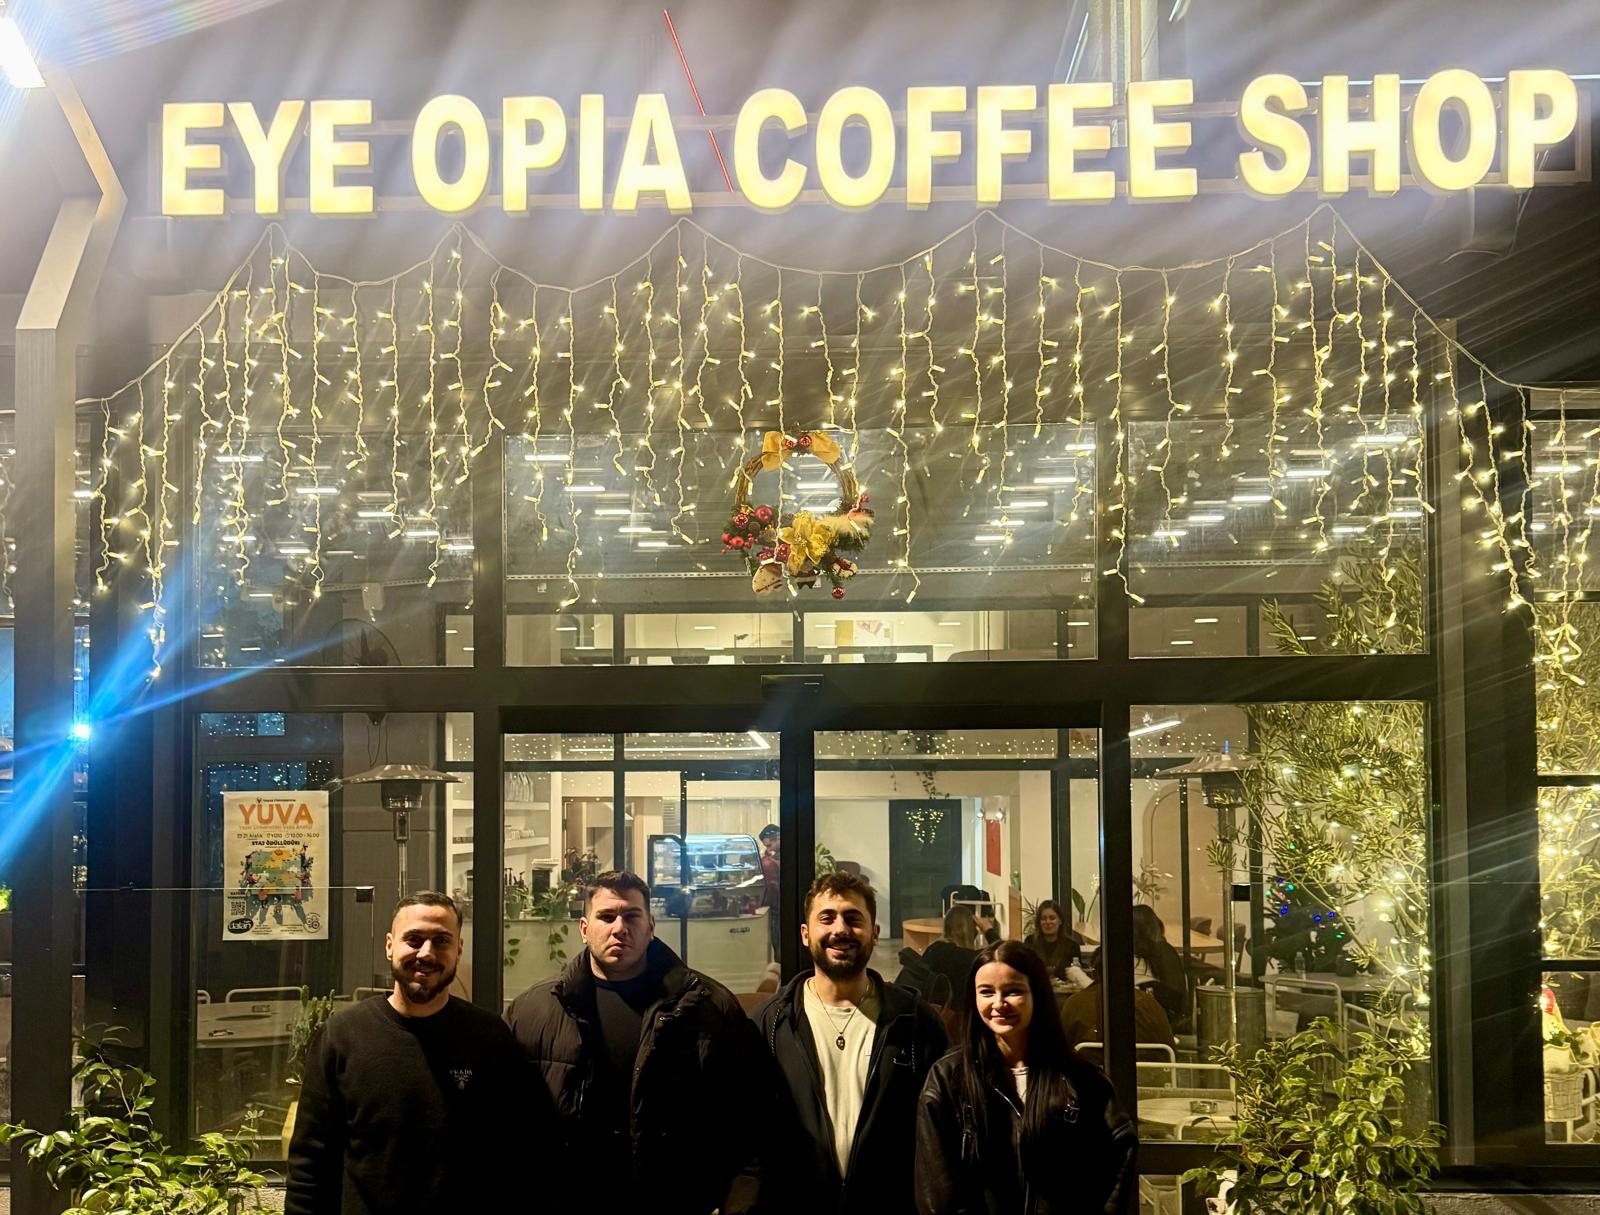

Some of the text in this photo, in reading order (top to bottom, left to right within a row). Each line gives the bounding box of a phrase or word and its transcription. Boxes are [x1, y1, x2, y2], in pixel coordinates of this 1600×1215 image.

[162, 68, 1578, 216] EYE OPIA COFFEE SHOP
[239, 803, 313, 825] YUVA
